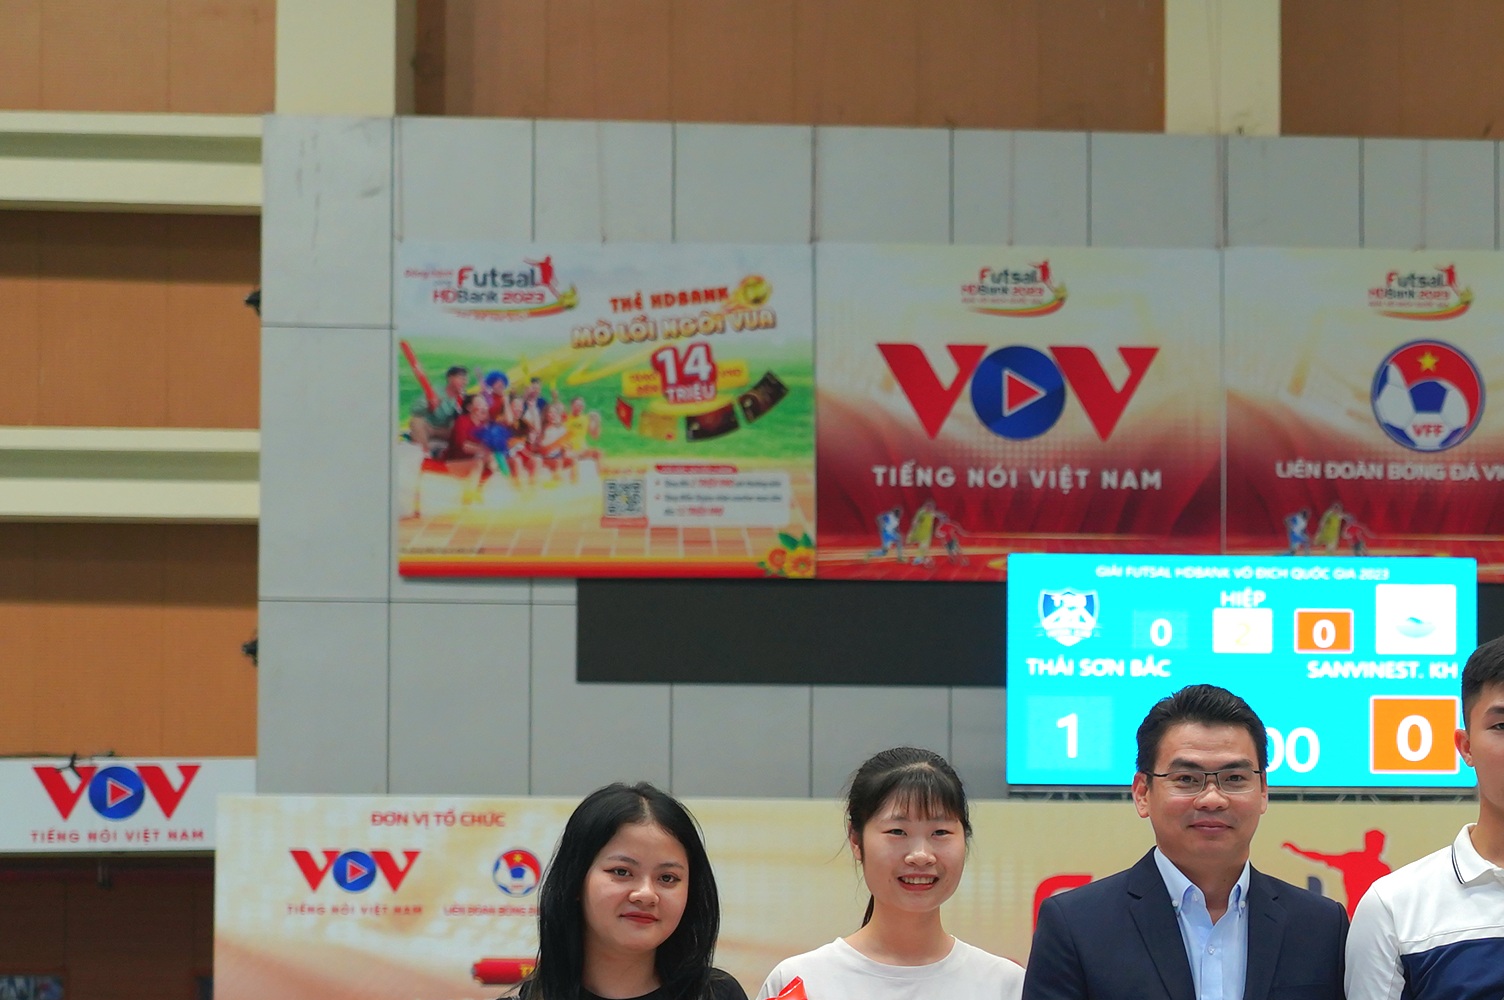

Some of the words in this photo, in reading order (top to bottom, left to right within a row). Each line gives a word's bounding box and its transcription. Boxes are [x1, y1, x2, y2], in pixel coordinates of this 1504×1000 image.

[457, 266, 536, 288] Futsal
[979, 266, 1038, 284] Futsal
[1386, 271, 1444, 288] Futsal
[432, 289, 499, 304] HDBank
[501, 292, 545, 304] 2023
[650, 287, 728, 309] HDBANK
[727, 308, 777, 333] VUA
[656, 343, 712, 385] 14
[666, 384, 715, 402] TRIỆU
[875, 342, 1161, 443] VOV
[1412, 424, 1444, 438] VFF
[872, 459, 956, 488] TIẾNG
[967, 461, 1018, 488] NÓI
[1028, 464, 1089, 495] VIỆT
[1100, 469, 1162, 491] NAM
[1275, 457, 1321, 480] LIÊN
[1325, 458, 1383, 481] ĐOÀN
[1387, 459, 1447, 482] BÓNG
[1450, 461, 1479, 483] ĐÁ
[1125, 565, 1172, 579] FUTSAL
[1332, 568, 1357, 580] GIA
[1148, 618, 1173, 647] 0
[1311, 619, 1337, 648] 0
[1026, 655, 1074, 677] THÁI
[1078, 656, 1127, 678] SƠN
[1429, 660, 1459, 679] KH
[1056, 712, 1078, 759] 1
[1396, 714, 1433, 761] 0
[32, 765, 201, 821] VOV
[371, 811, 409, 827] ĐƠN
[412, 813, 430, 829] VỊ
[460, 811, 506, 828] CHỨC
[31, 828, 80, 844] TIẾNG
[87, 830, 118, 843] NÓI
[125, 829, 161, 845] VIỆT
[168, 829, 204, 841] NAM
[289, 849, 421, 894] VOV
